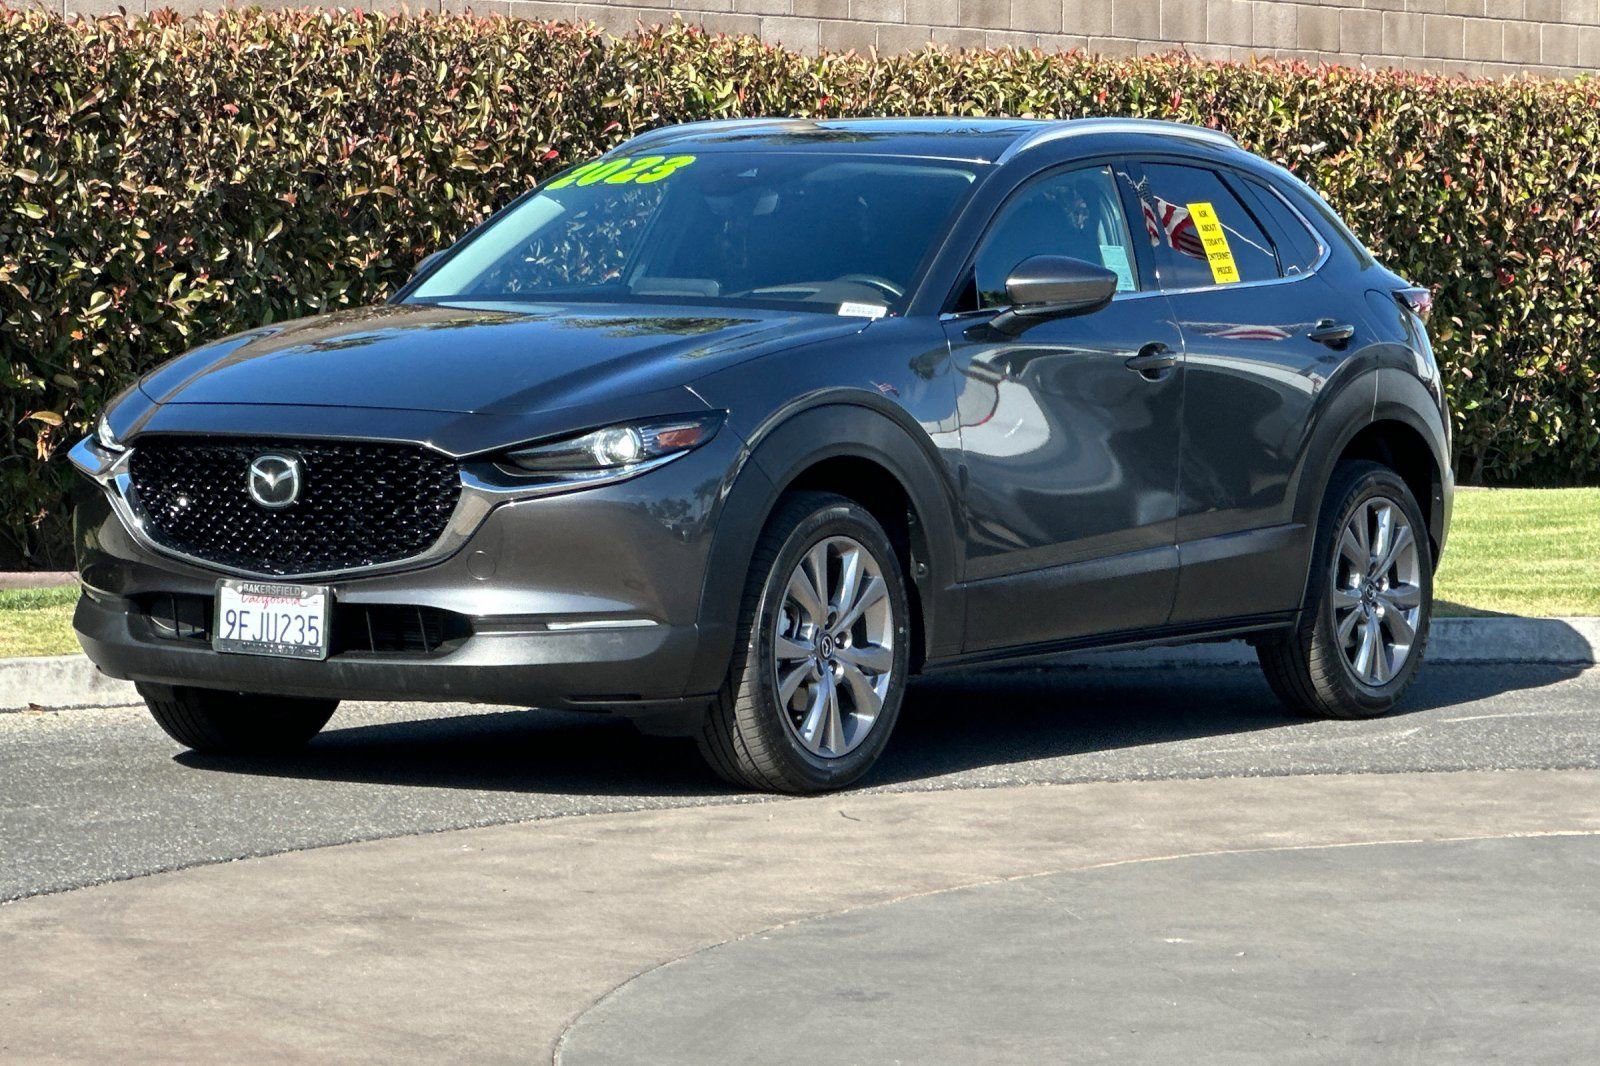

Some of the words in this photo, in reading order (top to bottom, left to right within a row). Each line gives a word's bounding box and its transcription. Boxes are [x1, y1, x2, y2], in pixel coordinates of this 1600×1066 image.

[544, 155, 697, 190] 2023
[1201, 224, 1217, 232] ABOUT
[1204, 238, 1225, 246] TODAY'S
[1208, 252, 1230, 261] INTERNET
[243, 583, 300, 596] BAKERSFIELD
[226, 609, 319, 646] 9FJU235
